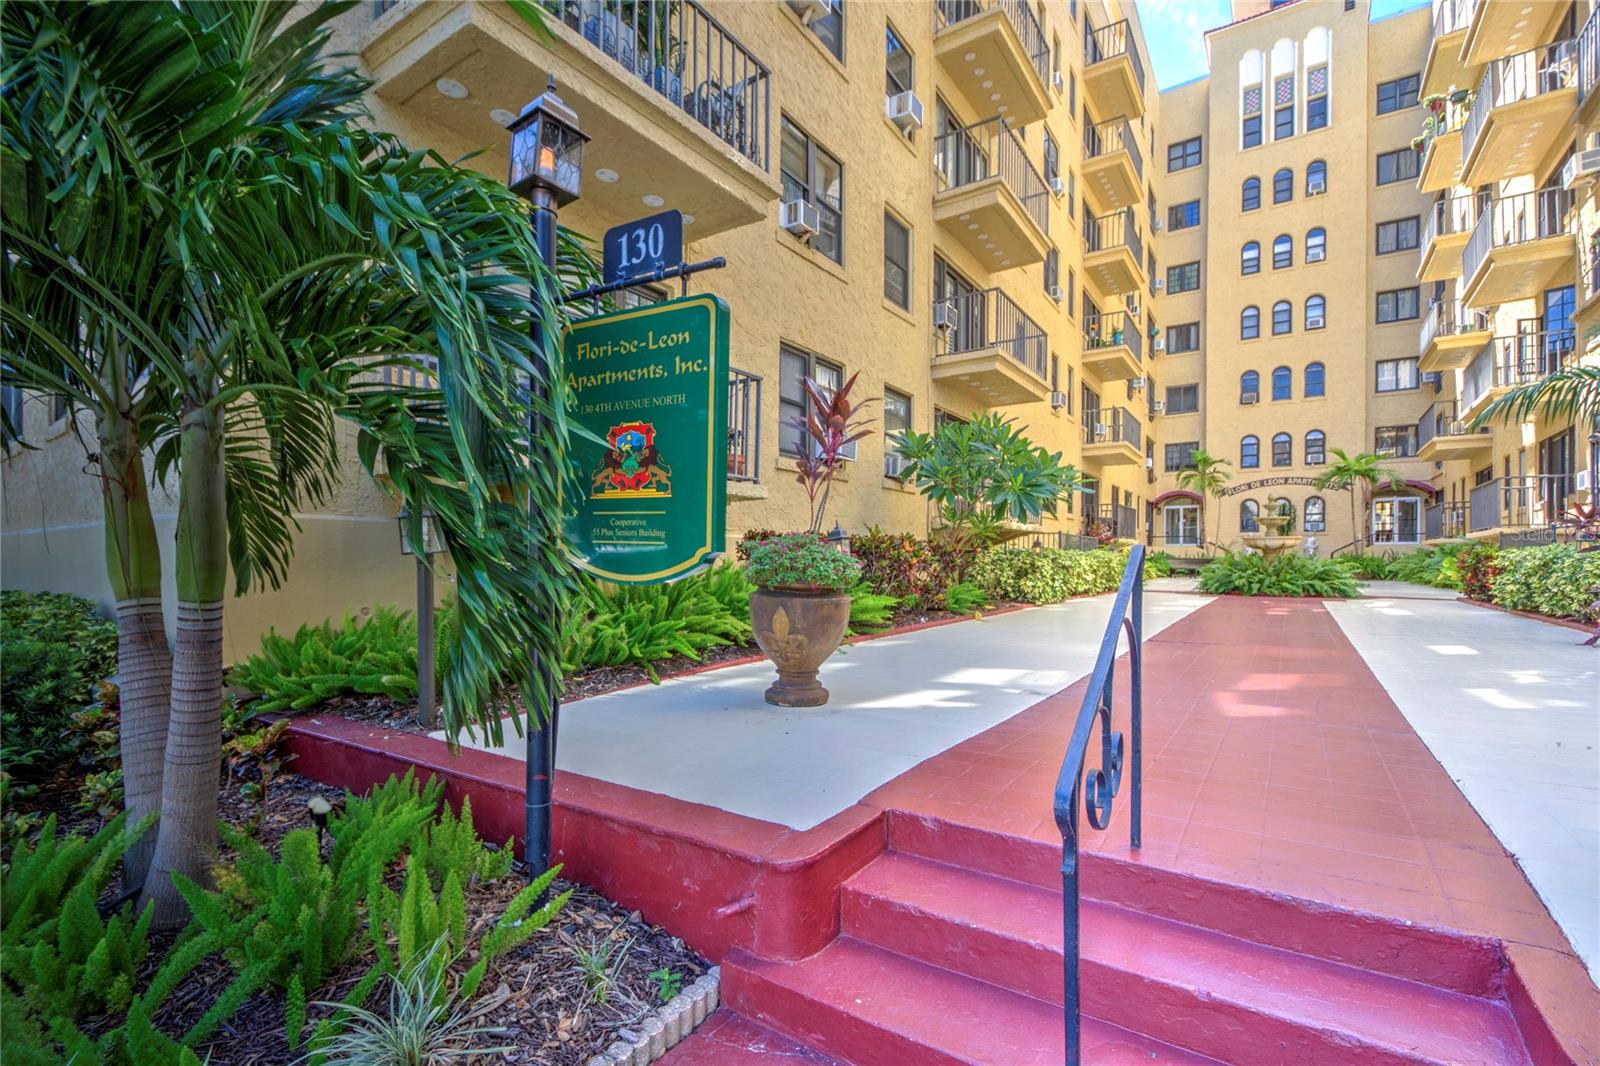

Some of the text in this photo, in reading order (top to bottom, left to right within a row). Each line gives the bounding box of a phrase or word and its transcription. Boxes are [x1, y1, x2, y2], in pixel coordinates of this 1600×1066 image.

[617, 223, 665, 269] 130
[576, 330, 691, 361] Flori-de-Leon
[567, 355, 709, 392] Apartments, Inc.
[581, 393, 686, 415] 130 4TH AVENUE NORTH
[1250, 481, 1261, 489] DE
[1264, 478, 1285, 486] LEON
[592, 528, 666, 539] 55 Plus Seniors Building
[610, 518, 647, 528] Cooperative
